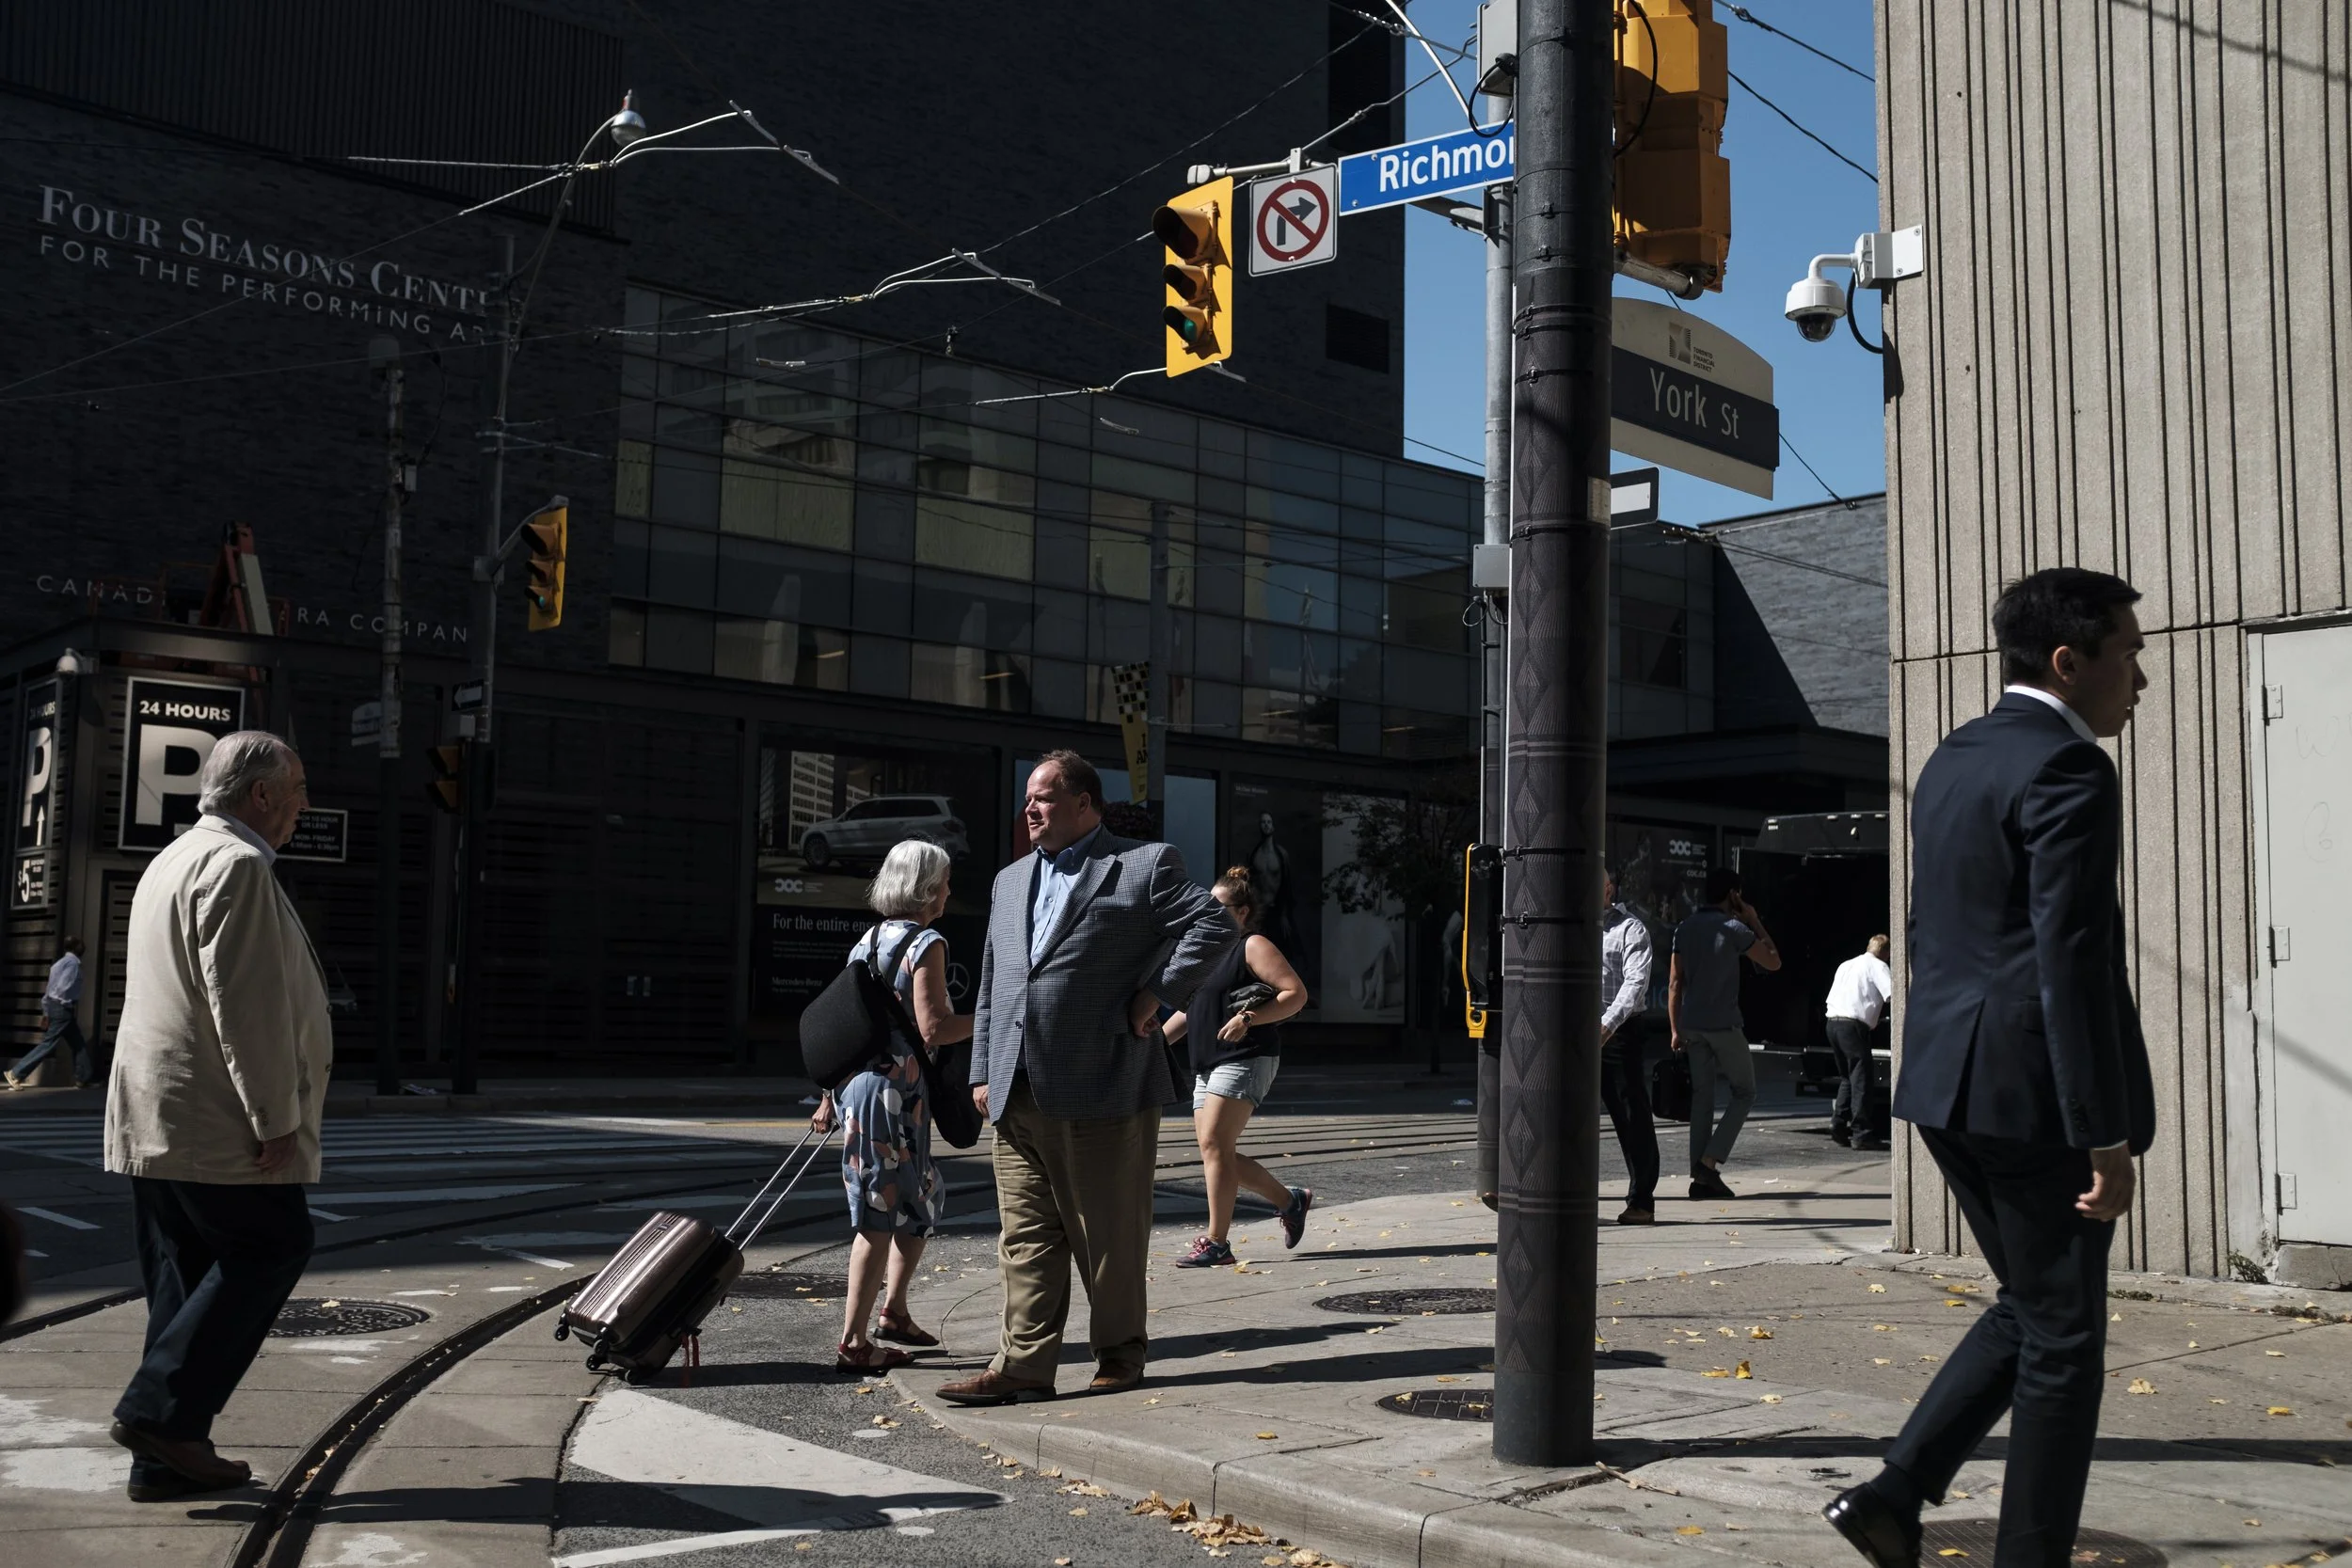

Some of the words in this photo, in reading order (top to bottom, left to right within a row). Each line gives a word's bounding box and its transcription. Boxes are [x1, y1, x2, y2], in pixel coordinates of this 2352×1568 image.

[1379, 136, 1513, 193] Richmo
[37, 184, 162, 249] FOUR
[179, 218, 355, 290] SEASONS
[40, 235, 110, 270] FOR
[135, 255, 200, 288] THE
[222, 274, 431, 335] PERFORMING
[1649, 367, 1708, 428] York
[1721, 403, 1739, 439] St
[1693, 361, 1712, 373] DISTRICT
[139, 700, 160, 716] 24
[165, 703, 231, 721] HOURS
[22, 726, 52, 828] P
[135, 723, 218, 826] P
[772, 912, 792, 929] For
[795, 913, 815, 930] the
[817, 917, 850, 932] entire
[851, 920, 877, 933] ens
